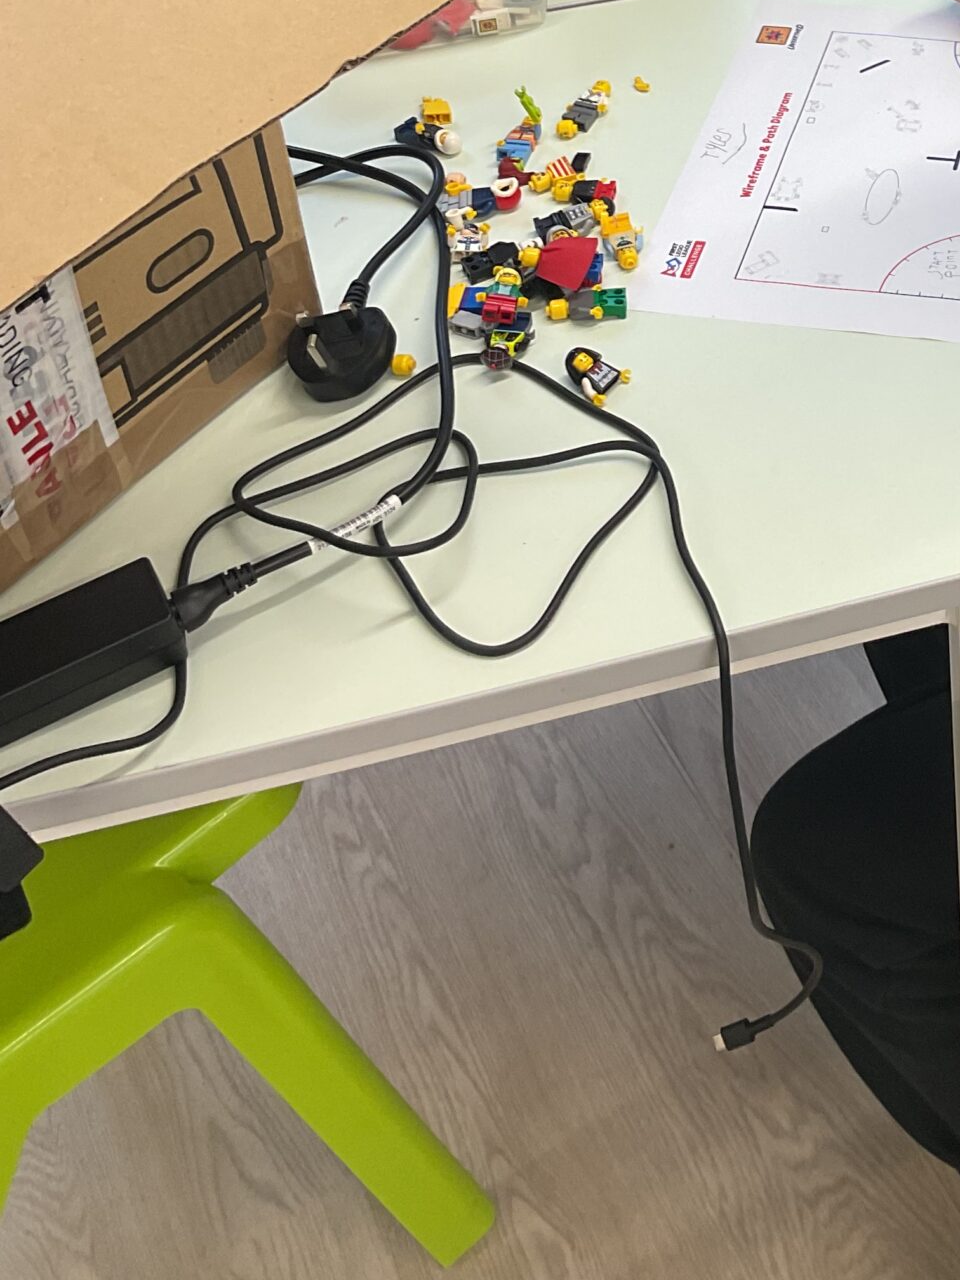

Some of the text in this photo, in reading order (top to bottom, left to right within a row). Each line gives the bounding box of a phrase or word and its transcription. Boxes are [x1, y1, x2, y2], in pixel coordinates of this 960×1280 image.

[770, 92, 793, 124] Diagram
[762, 125, 779, 145] Path
[740, 153, 767, 198] Wireframe
[668, 242, 679, 257] FIRST
[683, 243, 703, 277] CHALLENGE
